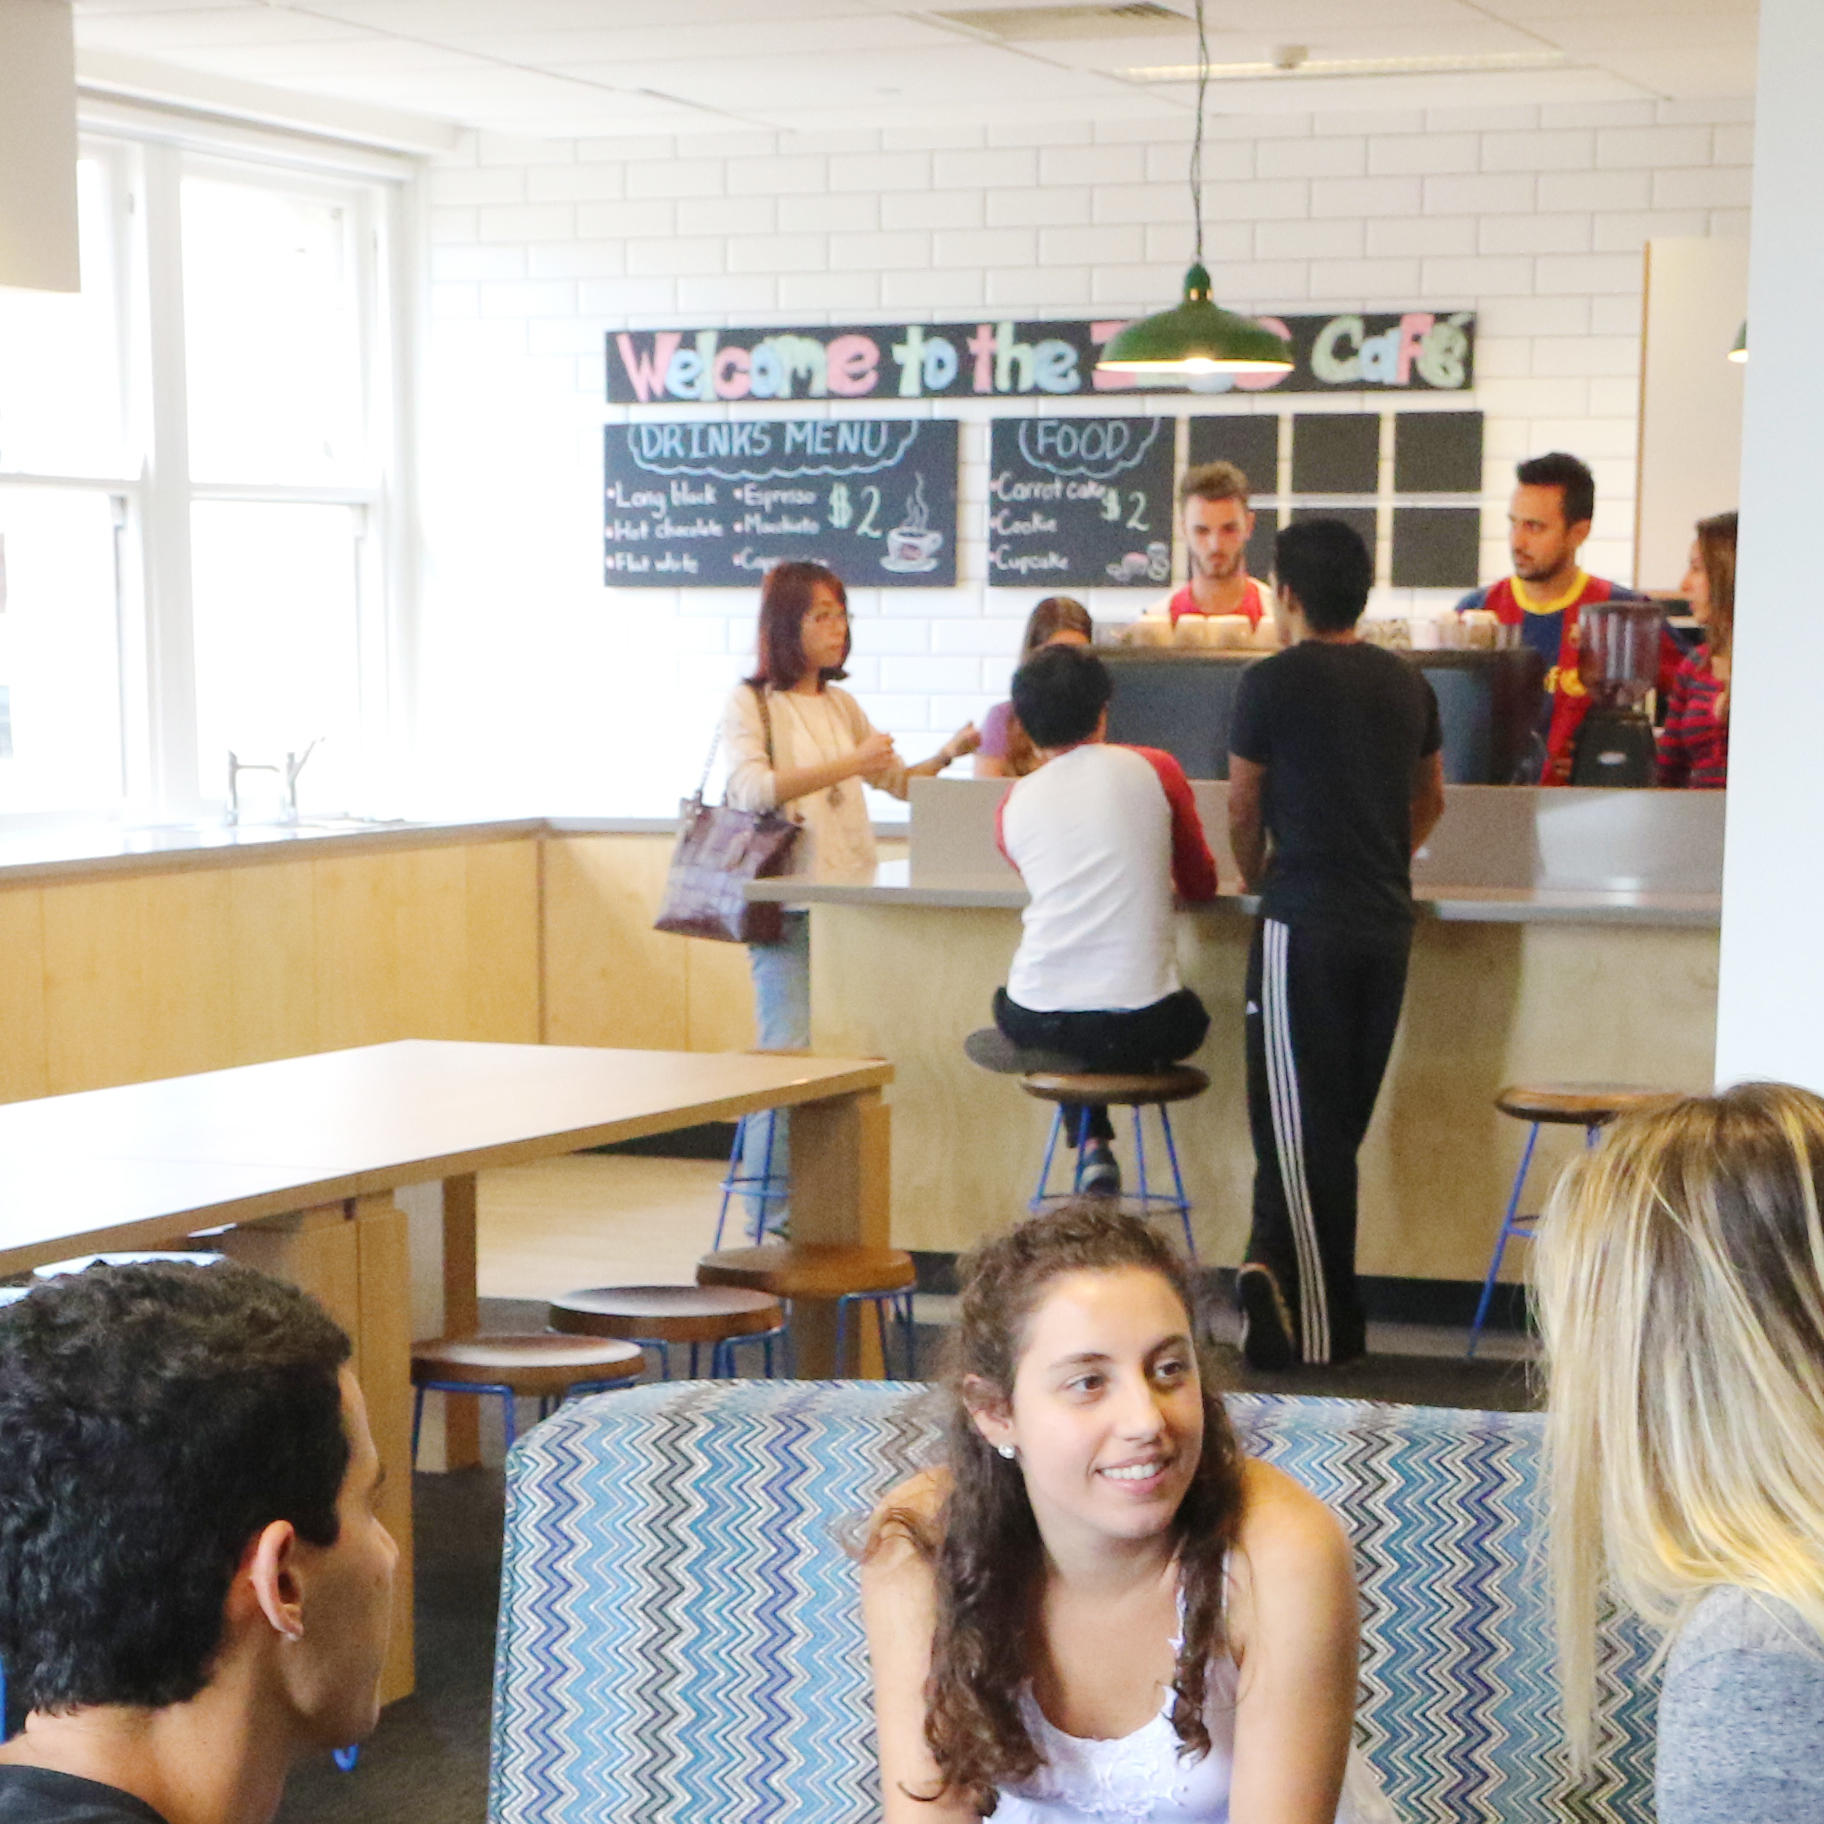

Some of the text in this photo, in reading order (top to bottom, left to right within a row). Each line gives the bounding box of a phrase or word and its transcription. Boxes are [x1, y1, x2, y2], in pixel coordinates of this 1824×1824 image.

[616, 330, 880, 401] Welcome
[892, 325, 959, 398] to
[967, 321, 1081, 393] the
[640, 421, 889, 459] DRINKS MENU
[1037, 420, 1130, 460] FOOD
[615, 480, 717, 519] Long black
[997, 471, 1063, 501] Carrot
[613, 519, 649, 541] Hot
[996, 508, 1058, 535] Cookie
[614, 551, 651, 573] Flat
[996, 543, 1070, 574] Cupcake
